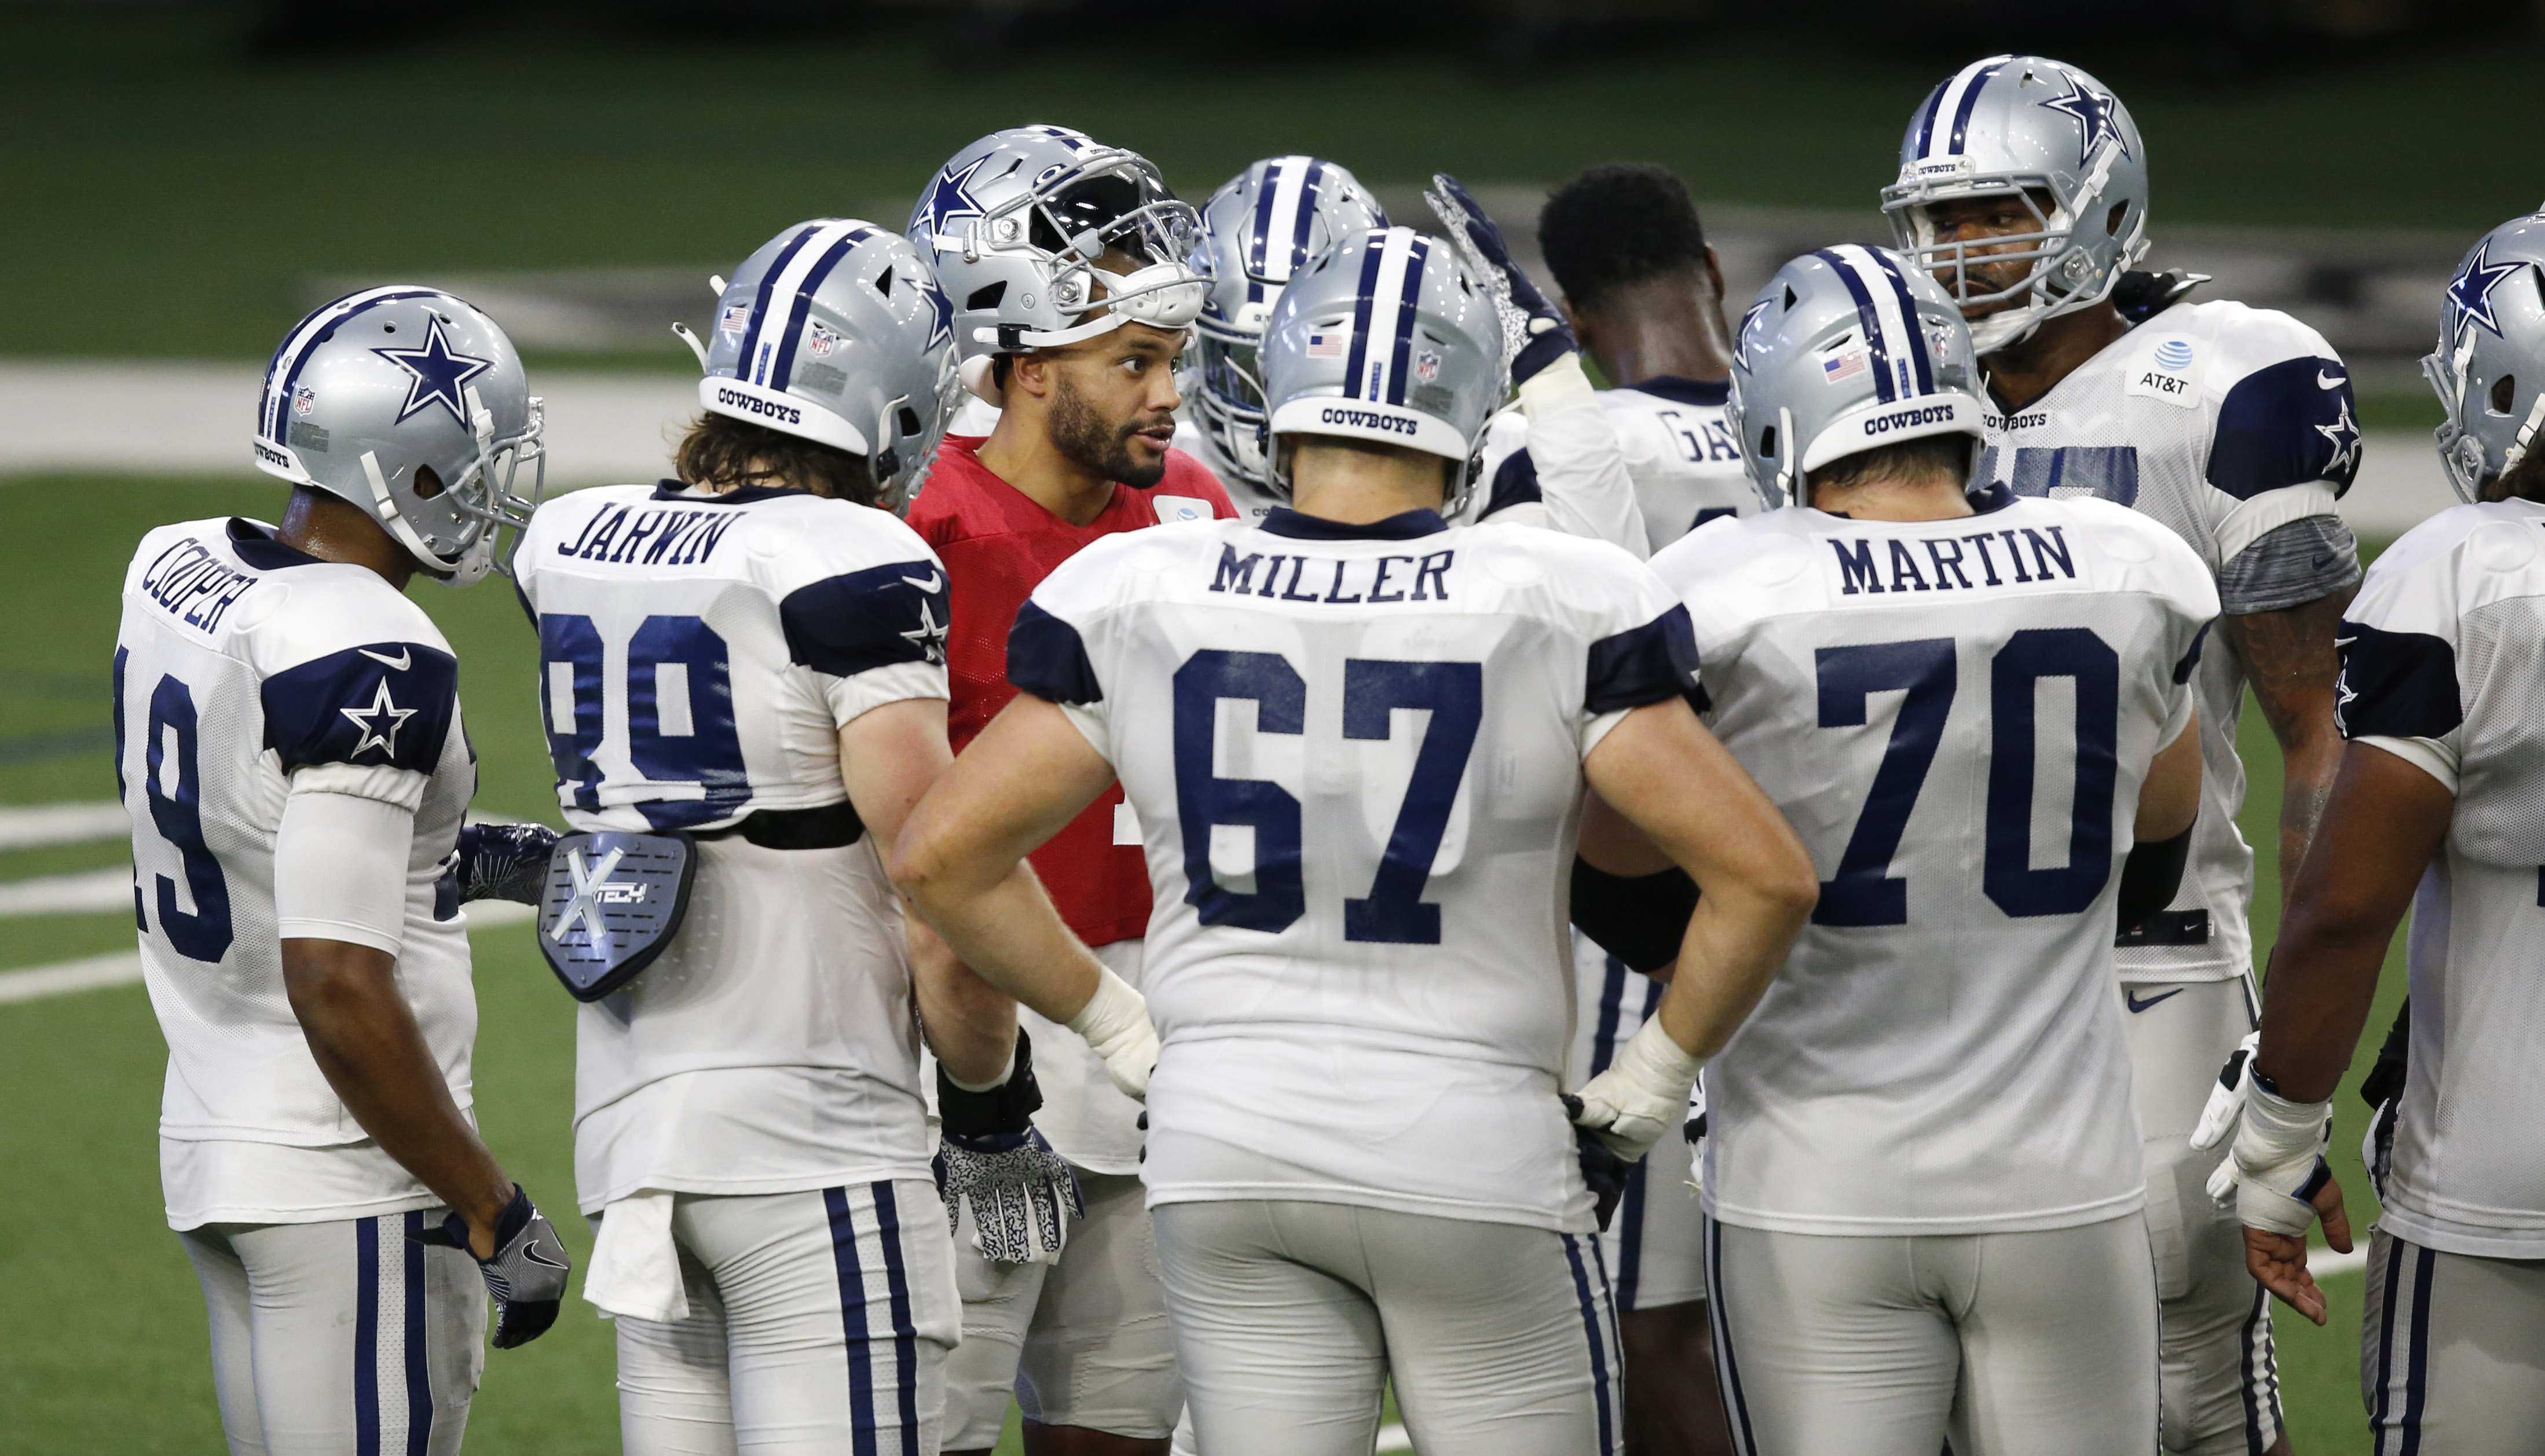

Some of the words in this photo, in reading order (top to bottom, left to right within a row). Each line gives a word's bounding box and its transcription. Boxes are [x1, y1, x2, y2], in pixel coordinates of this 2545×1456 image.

[1918, 164, 1956, 175] COWBOYS
[811, 339, 832, 354] NFL
[1418, 363, 1435, 379] NFL
[2140, 372, 2189, 395] AT&T
[296, 397, 310, 412] NFL
[719, 388, 800, 424] COWBOYS
[1322, 409, 1417, 435] COWBOYS
[1865, 405, 1953, 435] COWBOYS
[558, 502, 750, 565] JARWIN
[1209, 542, 1455, 603] MILLER
[1827, 526, 2076, 596] MARTIN
[142, 537, 259, 635] COOPER
[539, 613, 753, 829] 89
[1811, 627, 2119, 926] 70
[1173, 648, 1483, 945] 67
